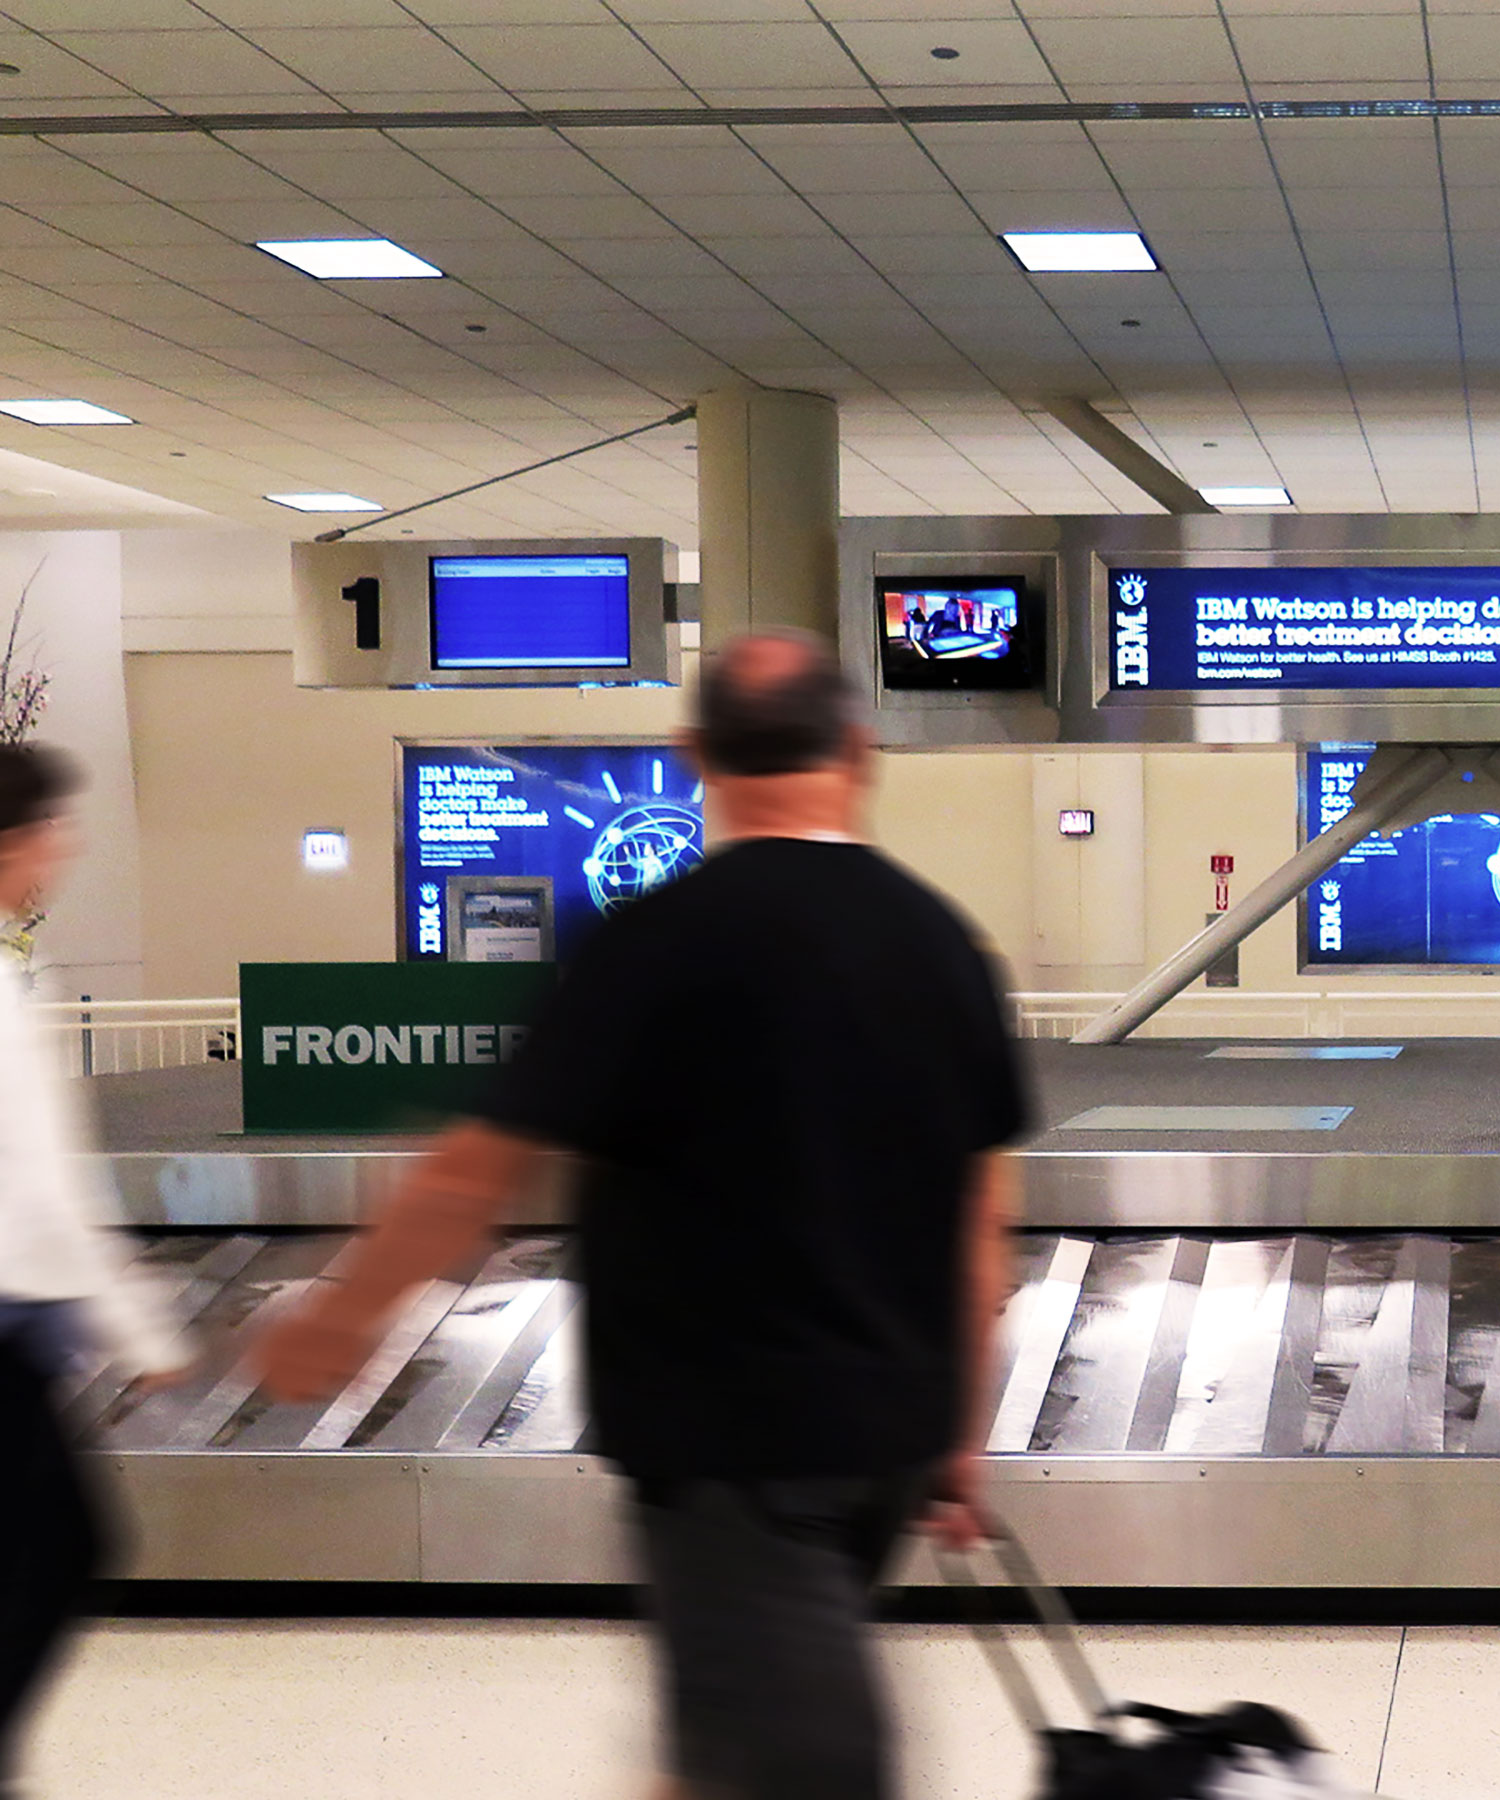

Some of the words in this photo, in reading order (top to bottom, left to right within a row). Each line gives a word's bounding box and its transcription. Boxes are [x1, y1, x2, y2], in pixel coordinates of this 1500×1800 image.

[342, 577, 380, 650] 1
[1196, 597, 1249, 620] IBM
[1251, 597, 1348, 620] Watson
[1351, 597, 1374, 620] is
[1377, 596, 1477, 625] helping
[1196, 623, 1273, 646] better
[1274, 622, 1402, 646] treatment
[1197, 651, 1219, 664] IBM
[1220, 651, 1259, 664] Watson
[1260, 651, 1275, 664] for
[1276, 651, 1307, 664] better
[1343, 650, 1365, 663] See
[1366, 652, 1379, 663] us
[1380, 651, 1391, 663] at
[1429, 650, 1461, 663] Booth
[419, 765, 451, 782] IBM
[453, 766, 514, 782] Watson
[1321, 762, 1355, 778] IBM
[419, 783, 433, 797] is
[435, 782, 498, 799] helping
[1321, 778, 1336, 793] is
[419, 797, 478, 811] doctors
[480, 795, 528, 811] make
[419, 903, 441, 953] IBM
[1320, 900, 1341, 951] IBM
